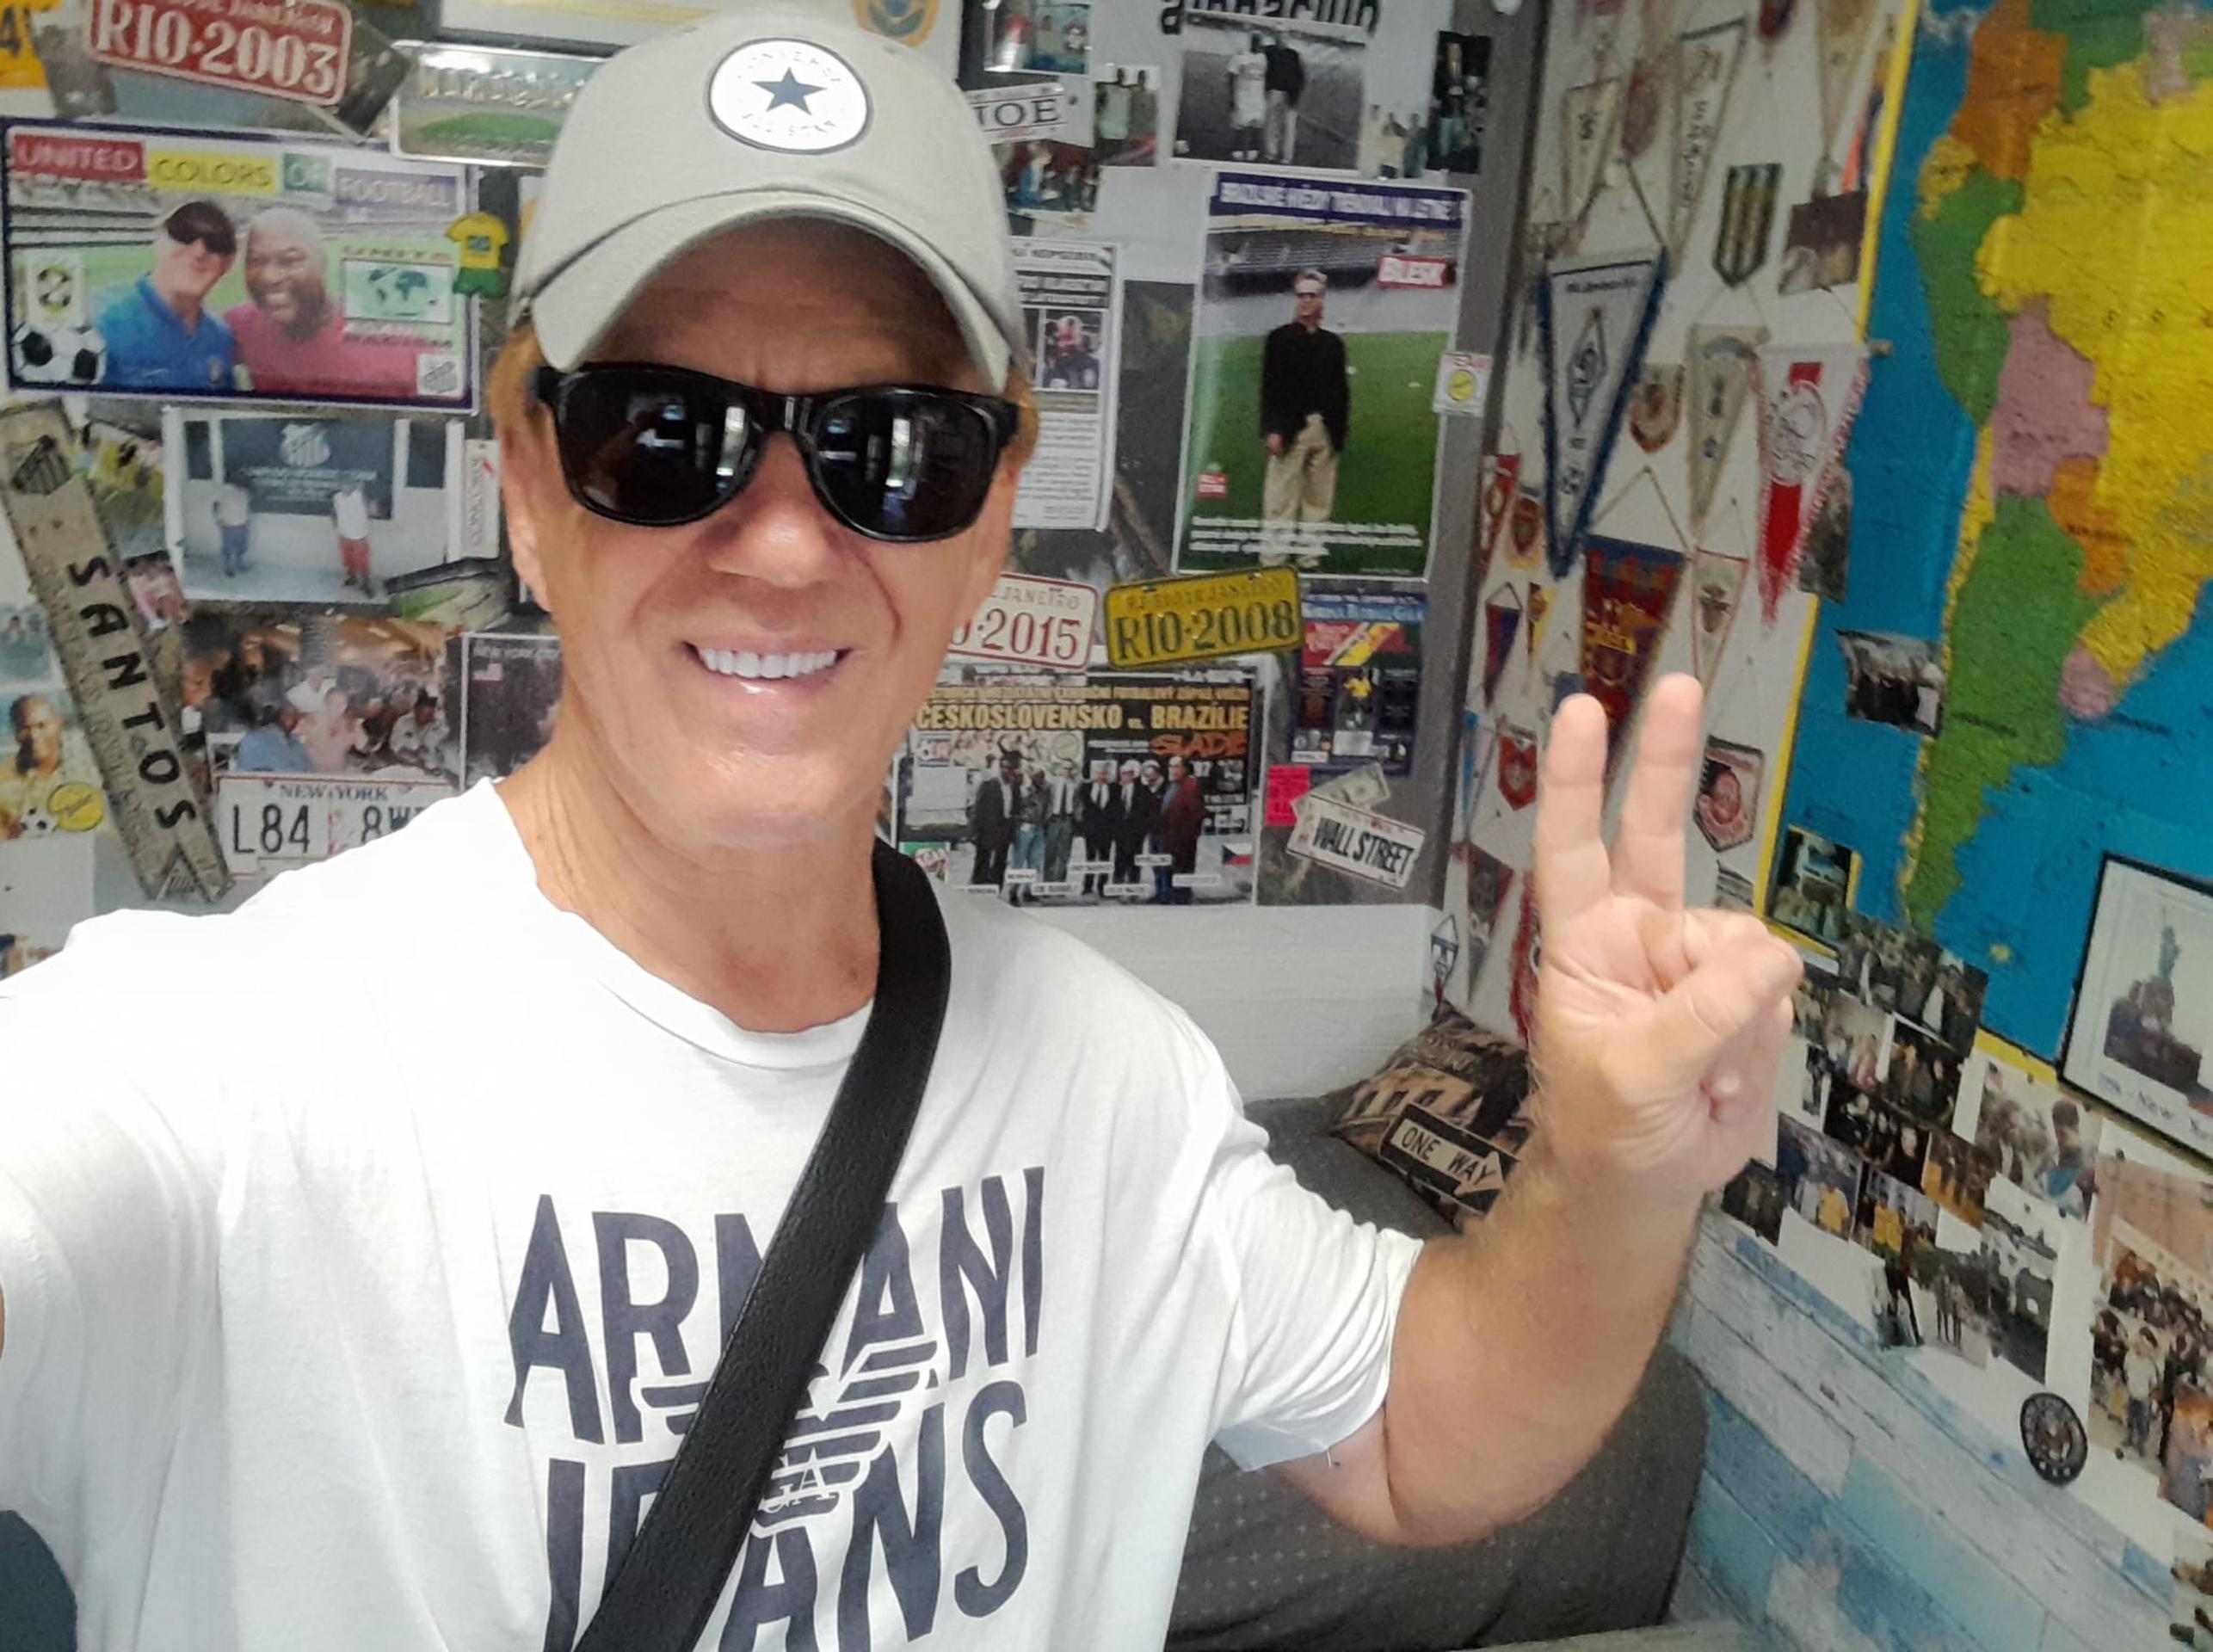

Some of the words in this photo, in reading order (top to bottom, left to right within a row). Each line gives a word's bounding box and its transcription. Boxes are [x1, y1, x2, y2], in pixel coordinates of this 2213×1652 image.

[18, 142, 139, 172] UNITED
[67, 555, 197, 831] SANTOS
[279, 784, 327, 799] NEW
[329, 785, 389, 801] YORK
[232, 804, 311, 854] L84
[361, 804, 429, 845] 8W
[1312, 816, 1356, 858] WALL
[1352, 830, 1416, 876] STREET
[1401, 1125, 1441, 1162] ONE
[1448, 1152, 1498, 1187] WAY
